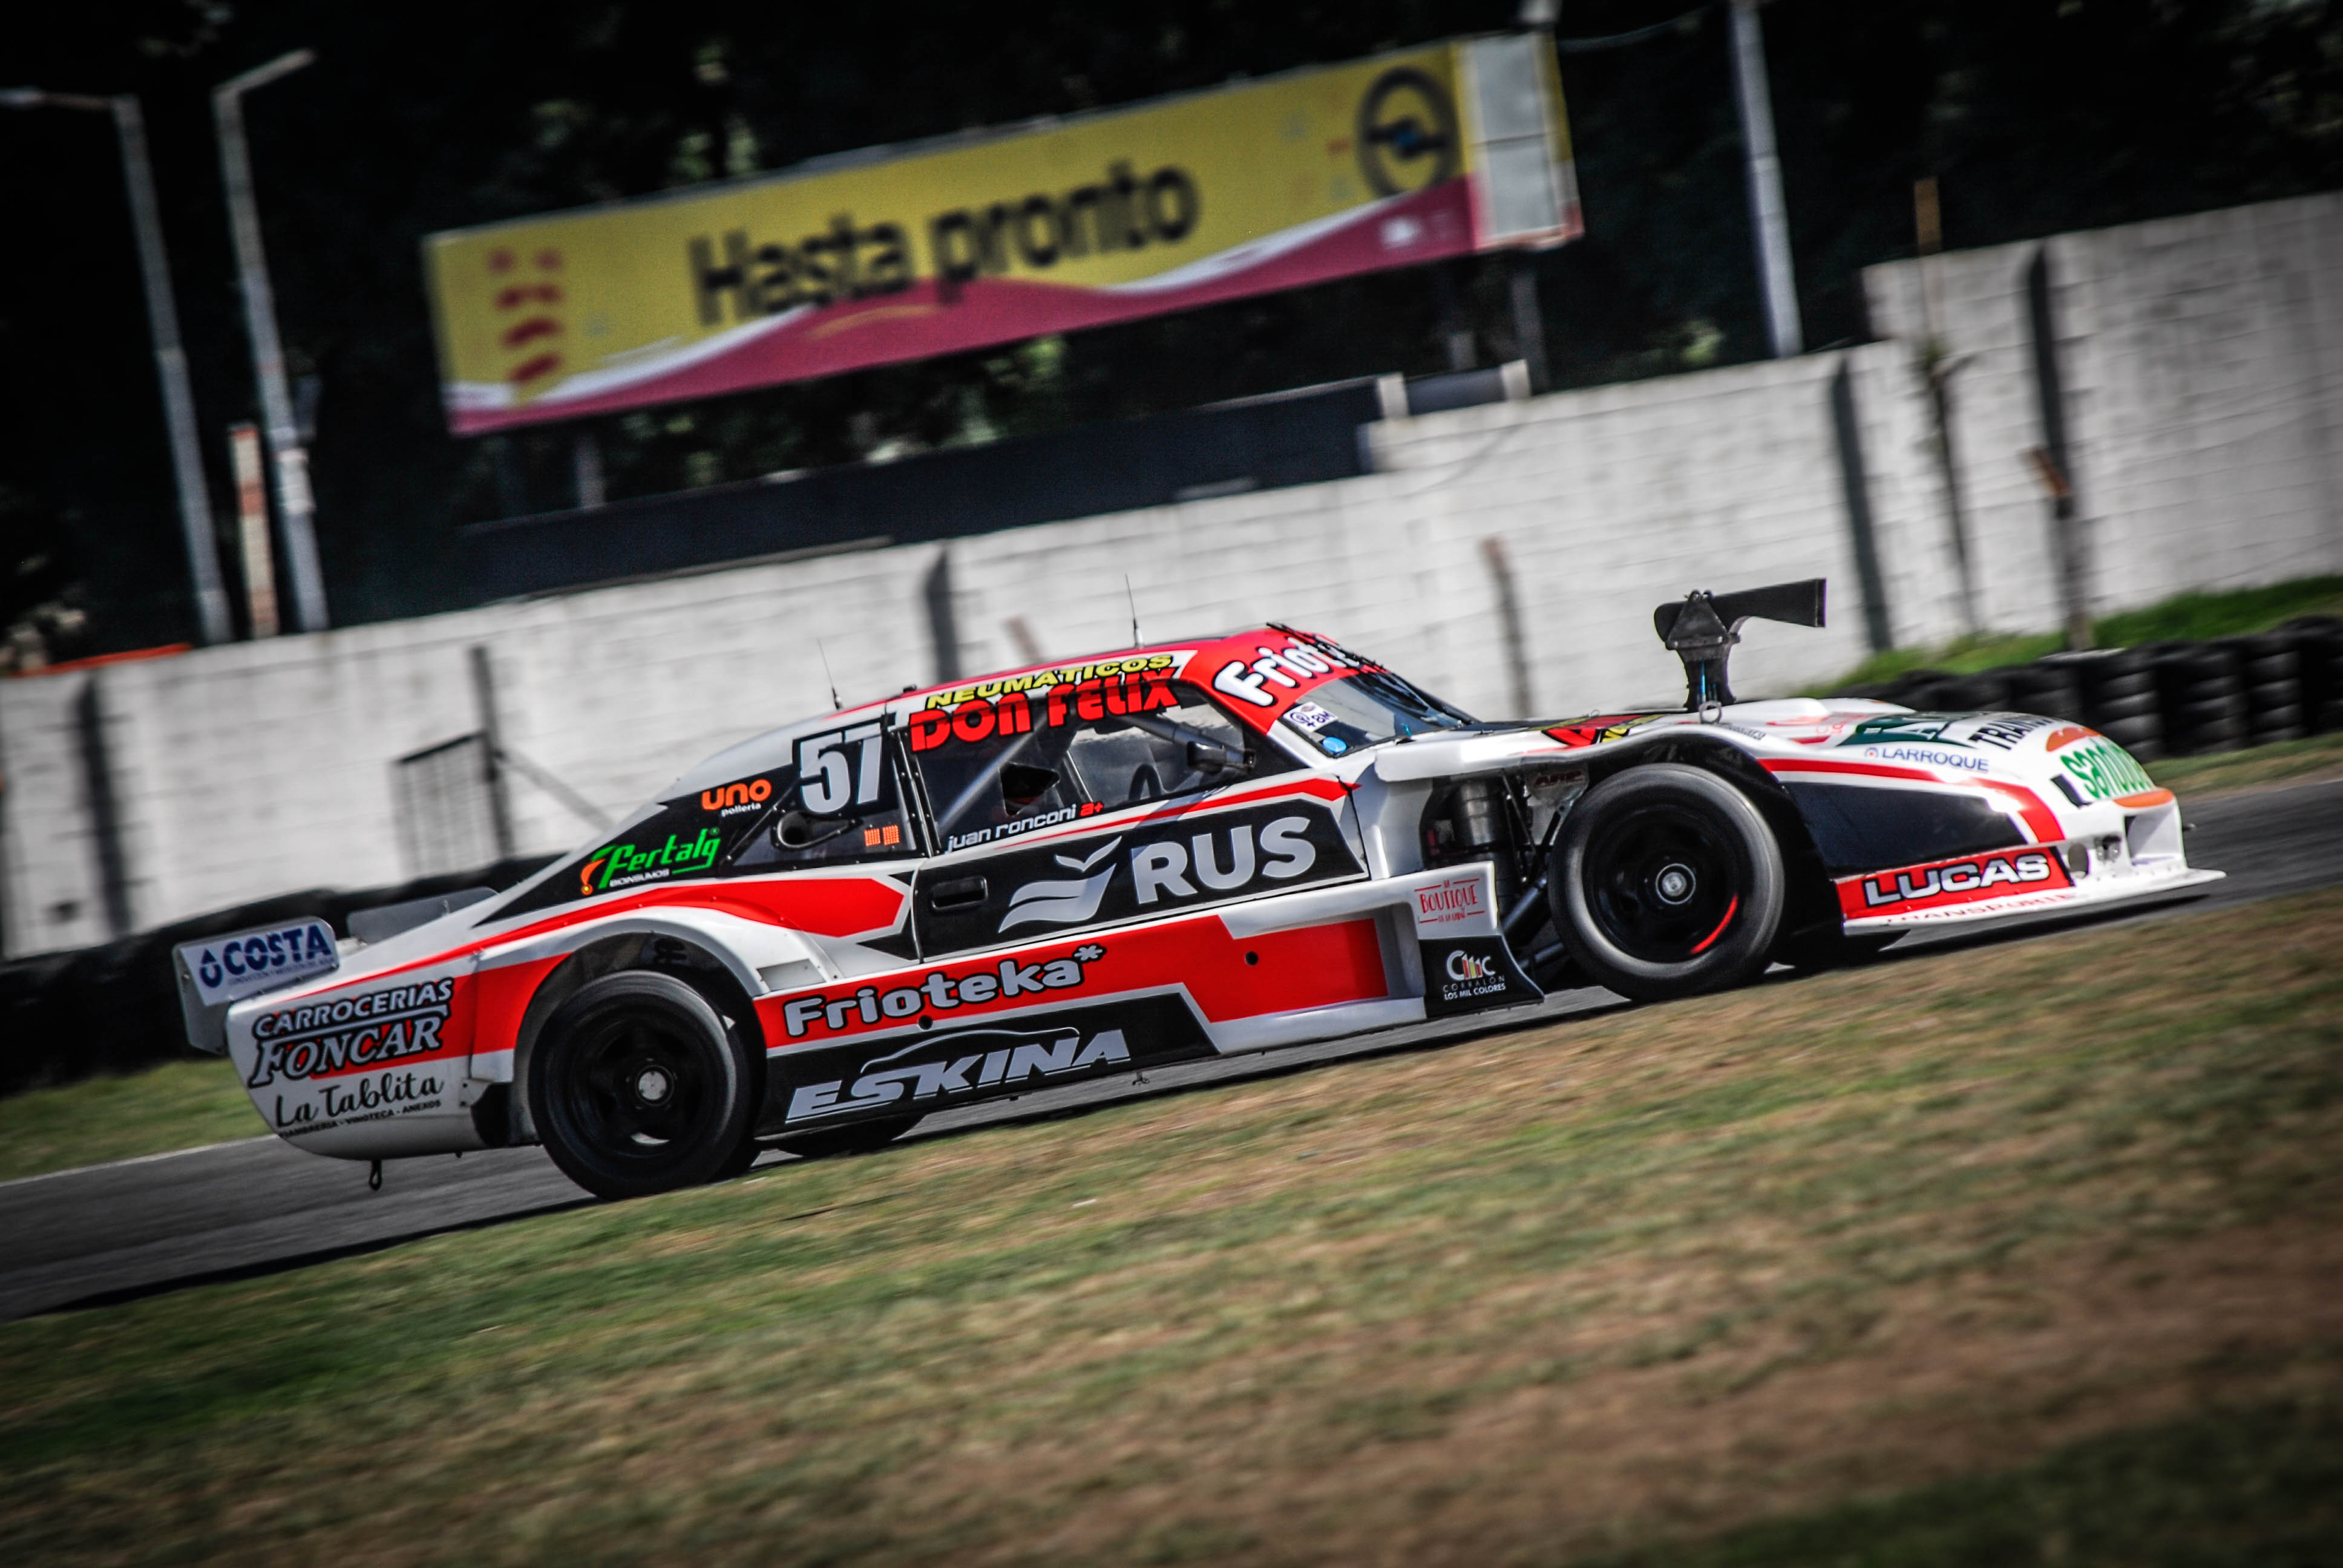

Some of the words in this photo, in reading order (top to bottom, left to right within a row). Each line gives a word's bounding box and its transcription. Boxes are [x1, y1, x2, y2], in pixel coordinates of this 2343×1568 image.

[686, 215, 915, 325] Hasta
[929, 160, 1202, 304] pronto
[1047, 668, 1178, 727] FELIX
[800, 724, 882, 814] 57
[1882, 748, 1990, 773] LARROQUE
[702, 779, 772, 810] uno
[945, 828, 991, 854] juan
[995, 803, 1077, 838] ronconi
[1133, 817, 1316, 905] RUS
[1864, 854, 2051, 907] LUCAS
[1420, 884, 1478, 913] BOUTIQUE
[222, 924, 332, 976] COSTA
[255, 978, 454, 1037] CARROCERIAS
[782, 957, 1084, 1037] Frioteka
[1444, 991, 1458, 1001] LOS
[1460, 989, 1472, 998] MIL
[1473, 983, 1506, 995] COLORES
[249, 1005, 449, 1088] FONCAR
[276, 1094, 319, 1128] La
[318, 1073, 445, 1118] Tablita
[785, 1030, 1131, 1125] ESKINA
[346, 1109, 395, 1125] VINOTECA
